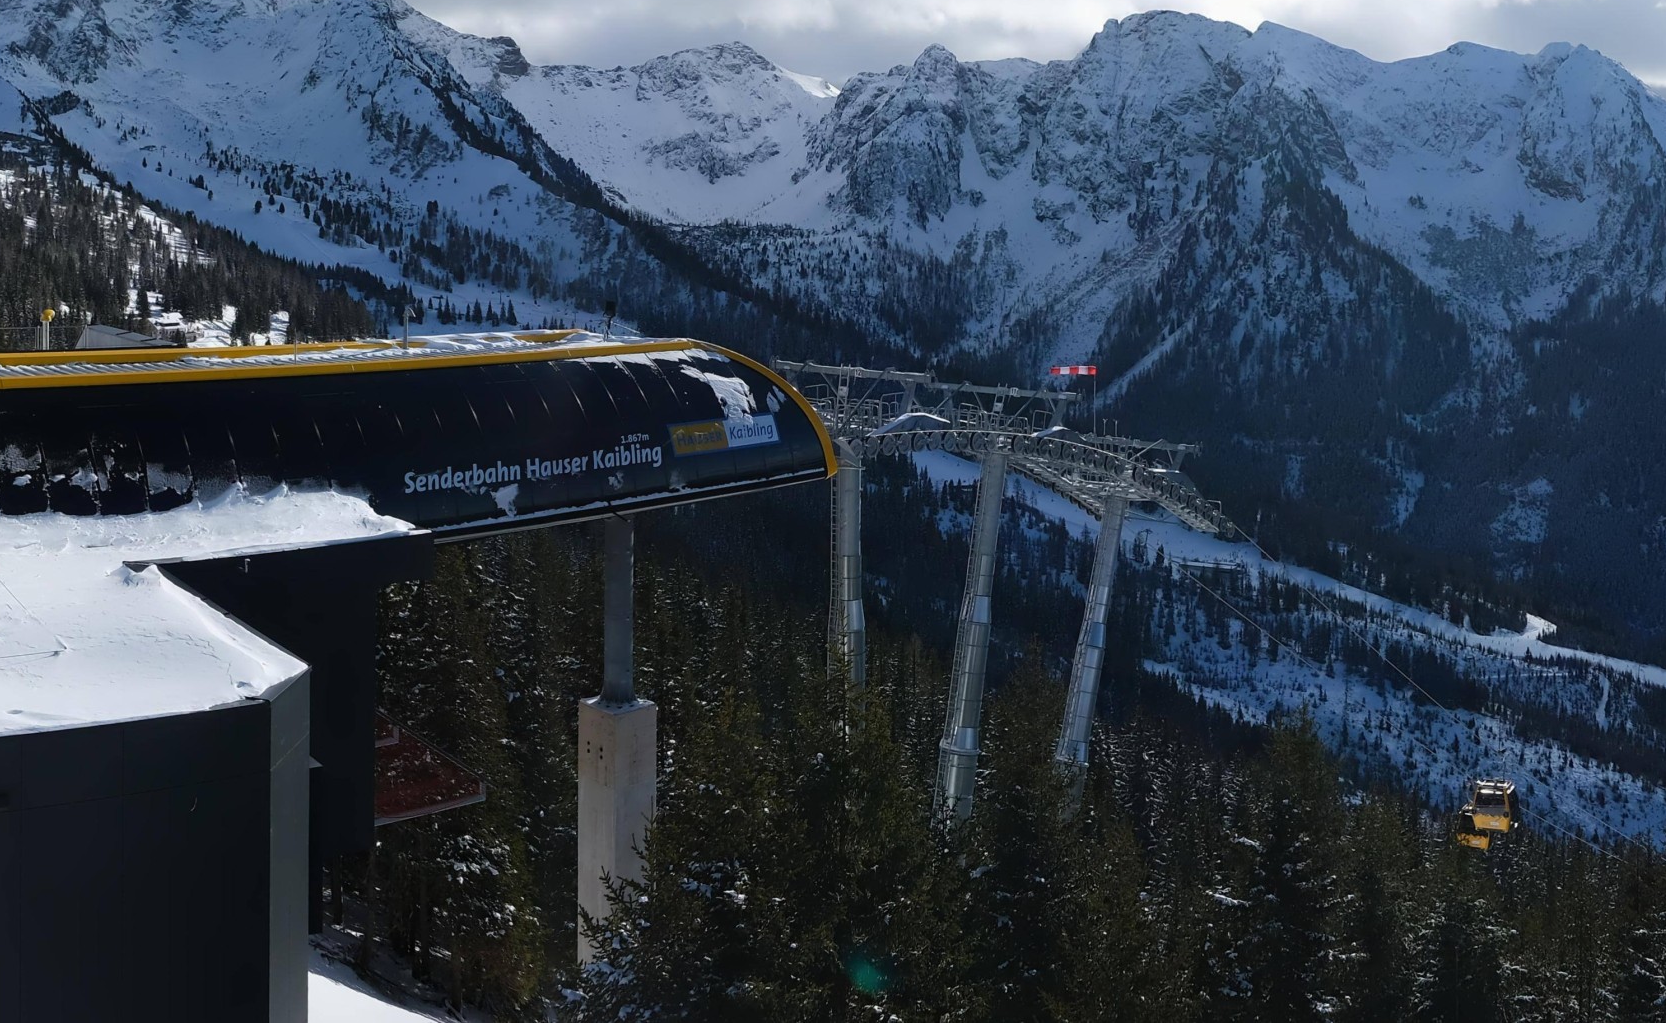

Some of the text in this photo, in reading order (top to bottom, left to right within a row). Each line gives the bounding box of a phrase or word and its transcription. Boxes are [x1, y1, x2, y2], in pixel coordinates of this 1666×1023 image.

[729, 424, 773, 440] Kaibling
[404, 443, 662, 494] Senderbahn Hauser Kaibling
